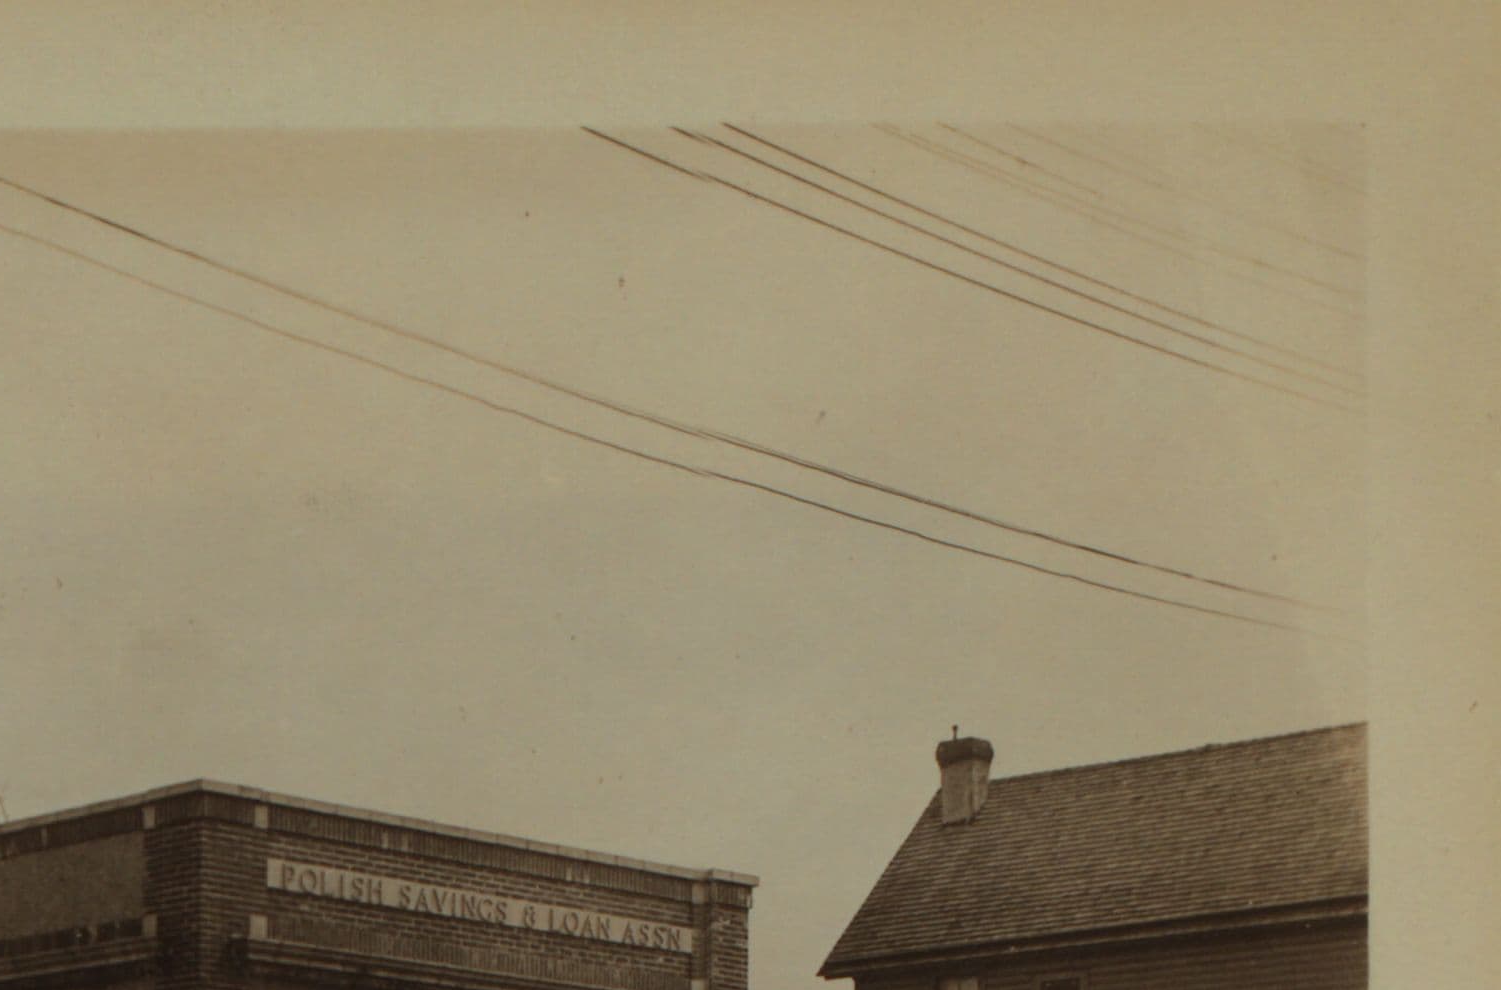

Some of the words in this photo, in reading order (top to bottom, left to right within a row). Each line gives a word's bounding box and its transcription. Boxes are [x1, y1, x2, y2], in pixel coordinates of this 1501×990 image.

[280, 863, 382, 903] POLISH
[399, 884, 508, 924] SAVINGS
[522, 904, 537, 930] &
[548, 909, 611, 940] LOAN
